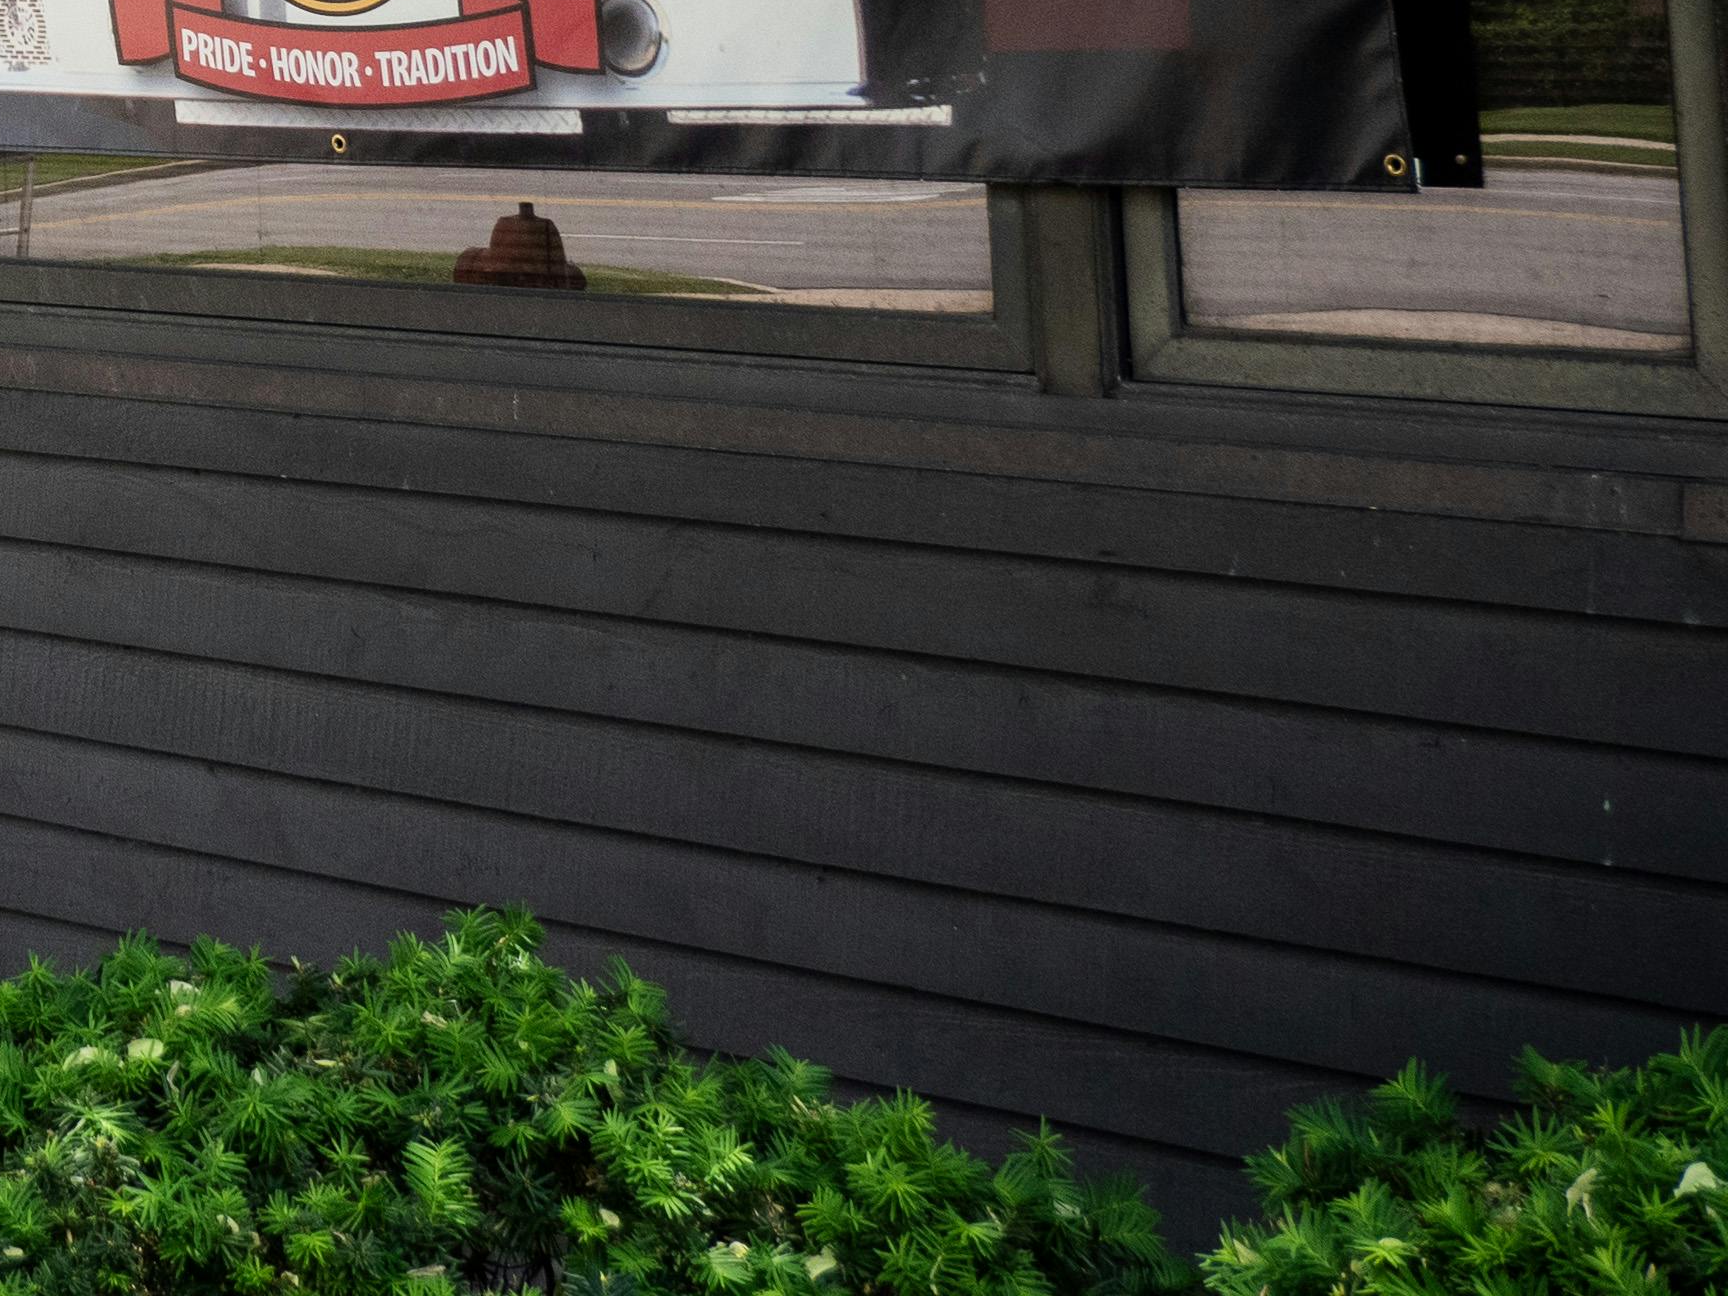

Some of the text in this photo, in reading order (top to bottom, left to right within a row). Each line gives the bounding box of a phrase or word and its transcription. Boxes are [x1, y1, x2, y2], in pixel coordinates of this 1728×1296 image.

[181, 28, 519, 87] PRIDE HONOR TRADITION
